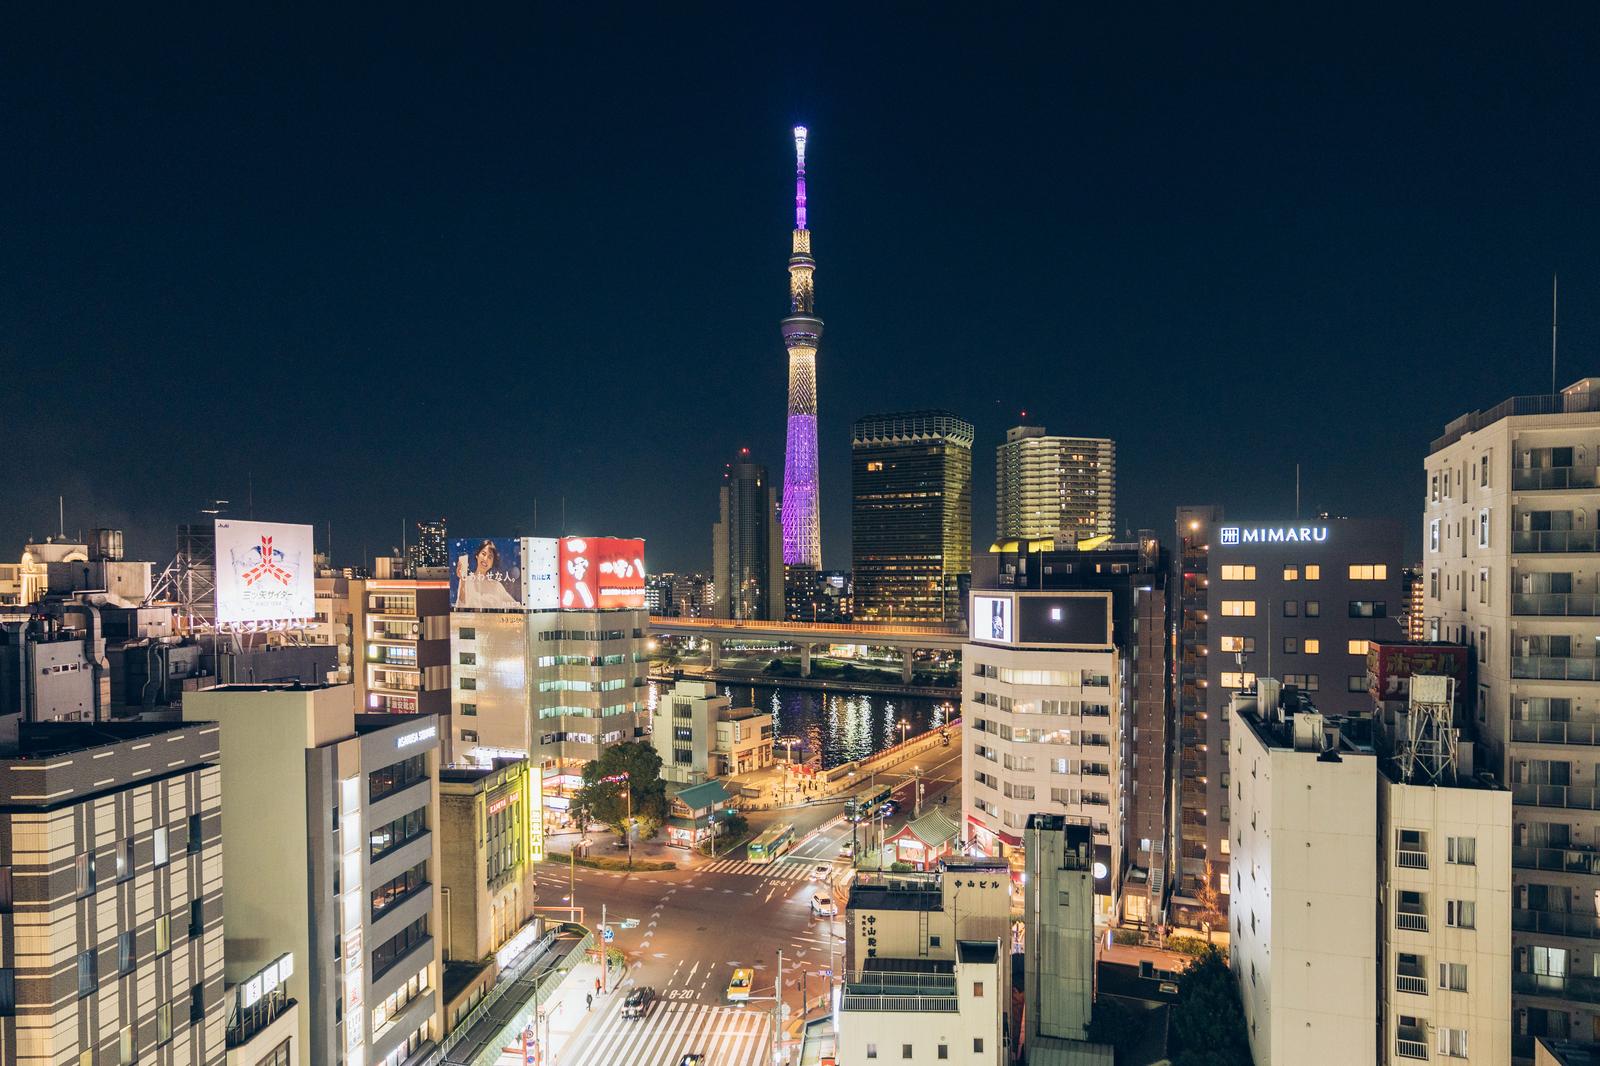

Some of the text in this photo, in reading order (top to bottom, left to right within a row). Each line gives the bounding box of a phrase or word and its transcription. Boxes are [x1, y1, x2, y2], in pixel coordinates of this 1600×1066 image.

[1243, 527, 1327, 542] MIMARU
[954, 879, 1000, 889] 中山ビル
[670, 989, 695, 1000] 8-20
